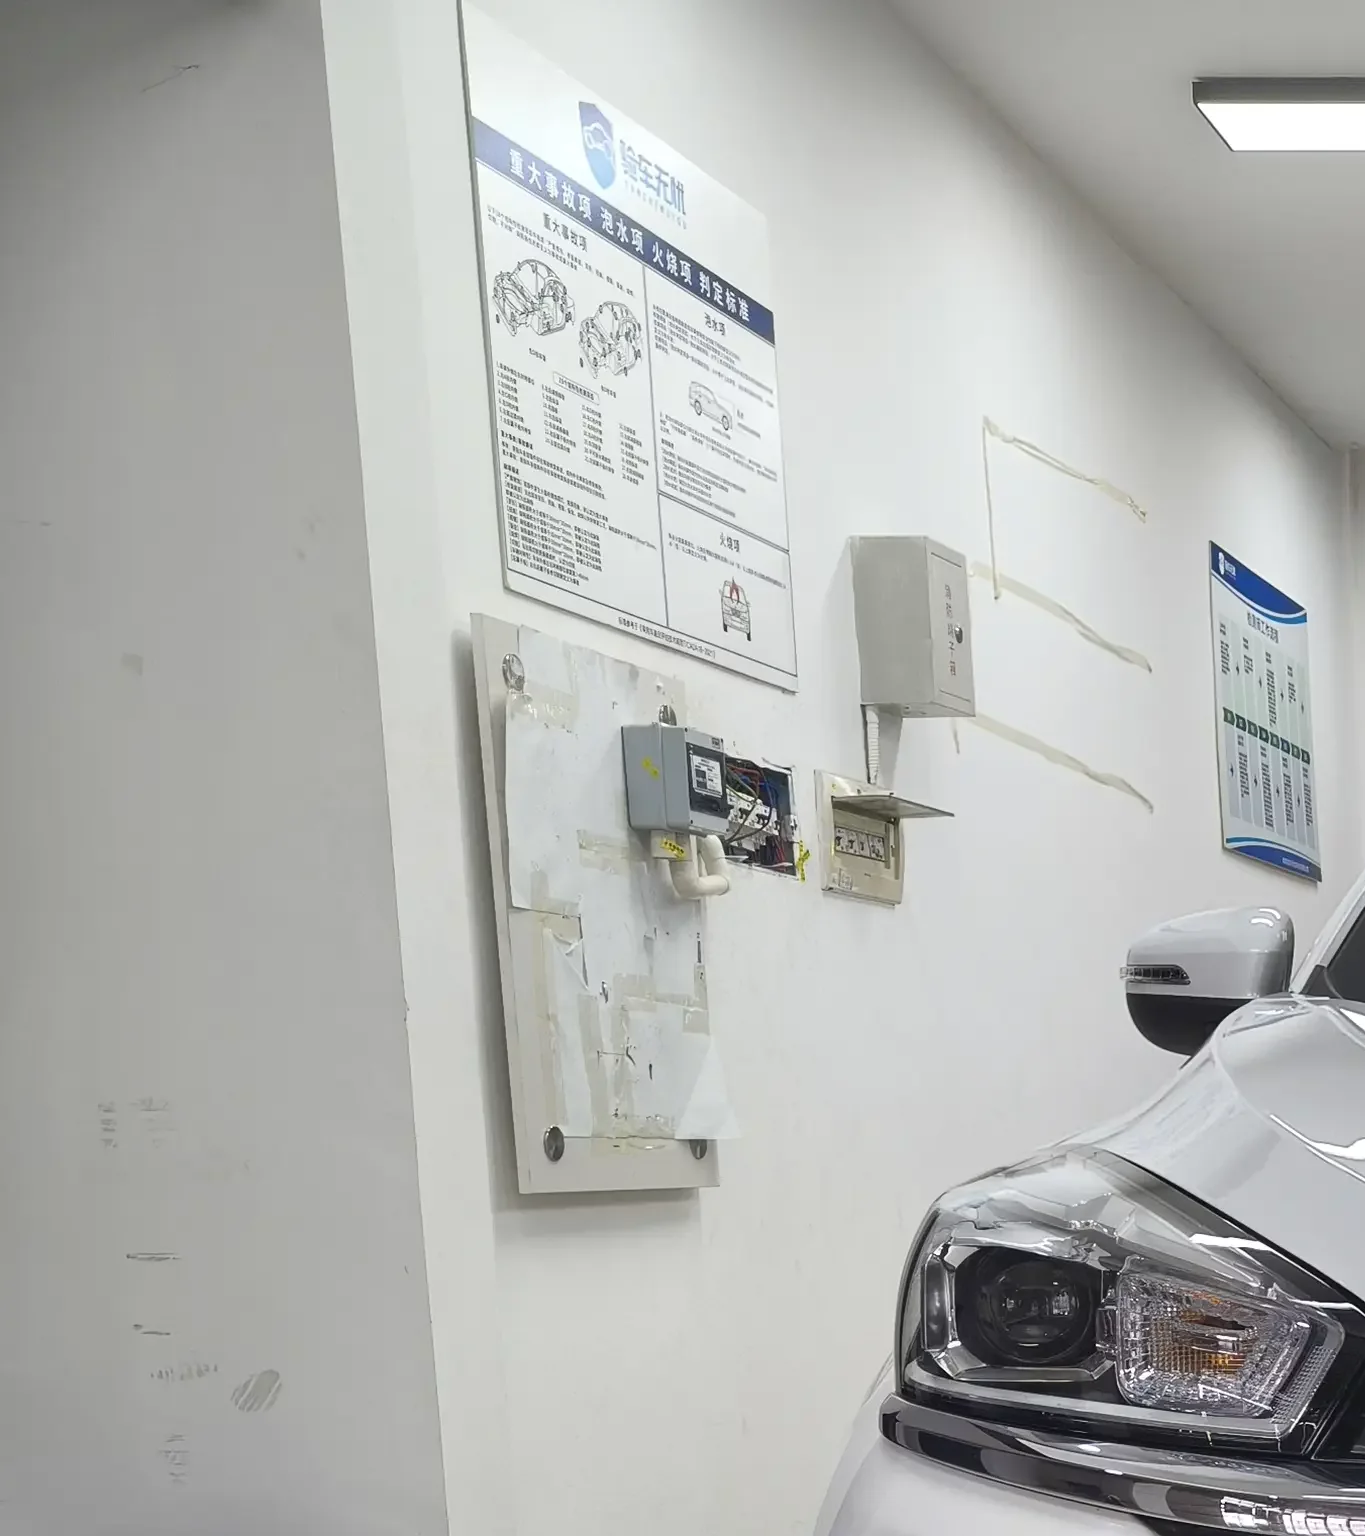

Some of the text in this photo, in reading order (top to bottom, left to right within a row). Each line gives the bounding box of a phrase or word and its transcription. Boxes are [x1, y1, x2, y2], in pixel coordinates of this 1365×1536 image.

[509, 149, 593, 223] 重大事故项
[601, 207, 645, 255] 泡水项
[652, 242, 693, 286] 火烧项
[699, 271, 751, 323] 判定标准
[542, 212, 588, 254] 重大事故项
[704, 312, 727, 338] 泡水项
[719, 531, 741, 554] 火烧项
